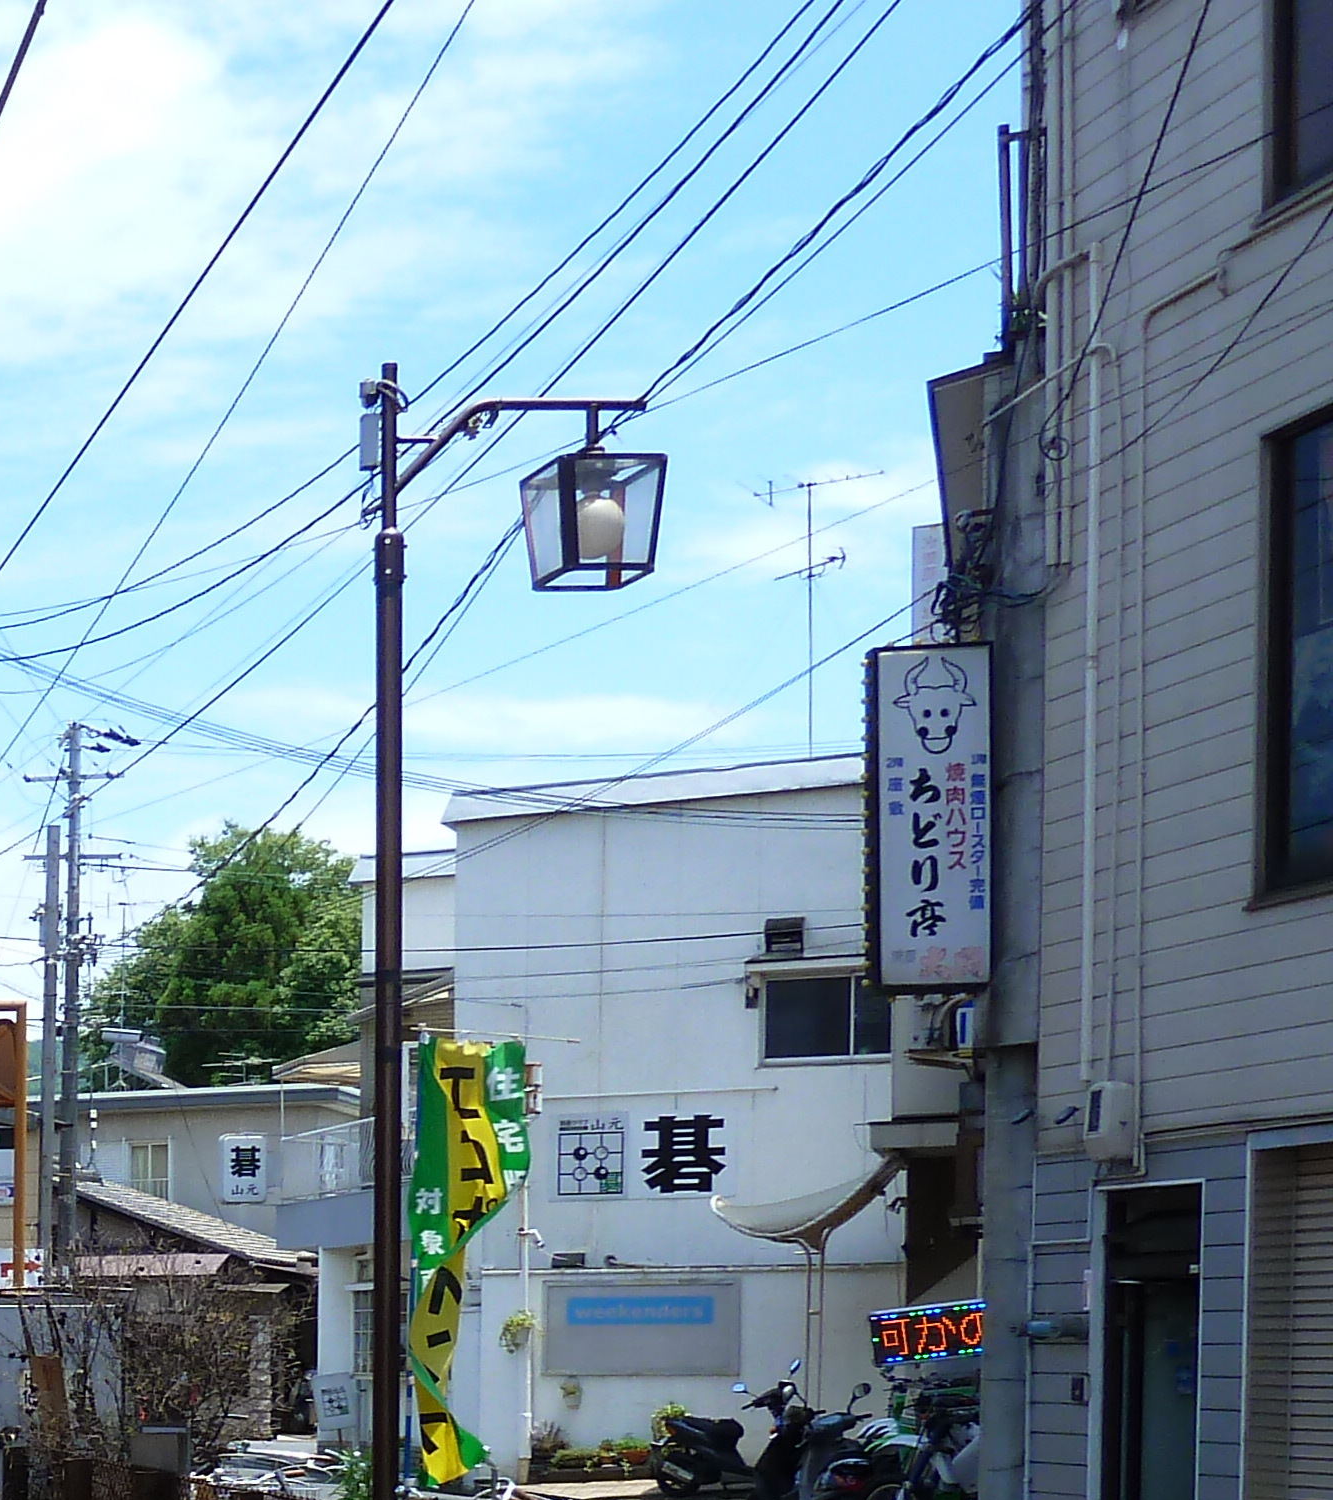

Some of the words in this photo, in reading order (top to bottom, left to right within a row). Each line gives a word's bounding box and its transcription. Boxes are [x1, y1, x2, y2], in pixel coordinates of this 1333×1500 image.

[905, 767, 947, 938] ちどり亭
[944, 762, 968, 871] 焼肉ハウス
[230, 1145, 261, 1178] 碁
[231, 1183, 259, 1196] 山元
[641, 1114, 727, 1193] 碁
